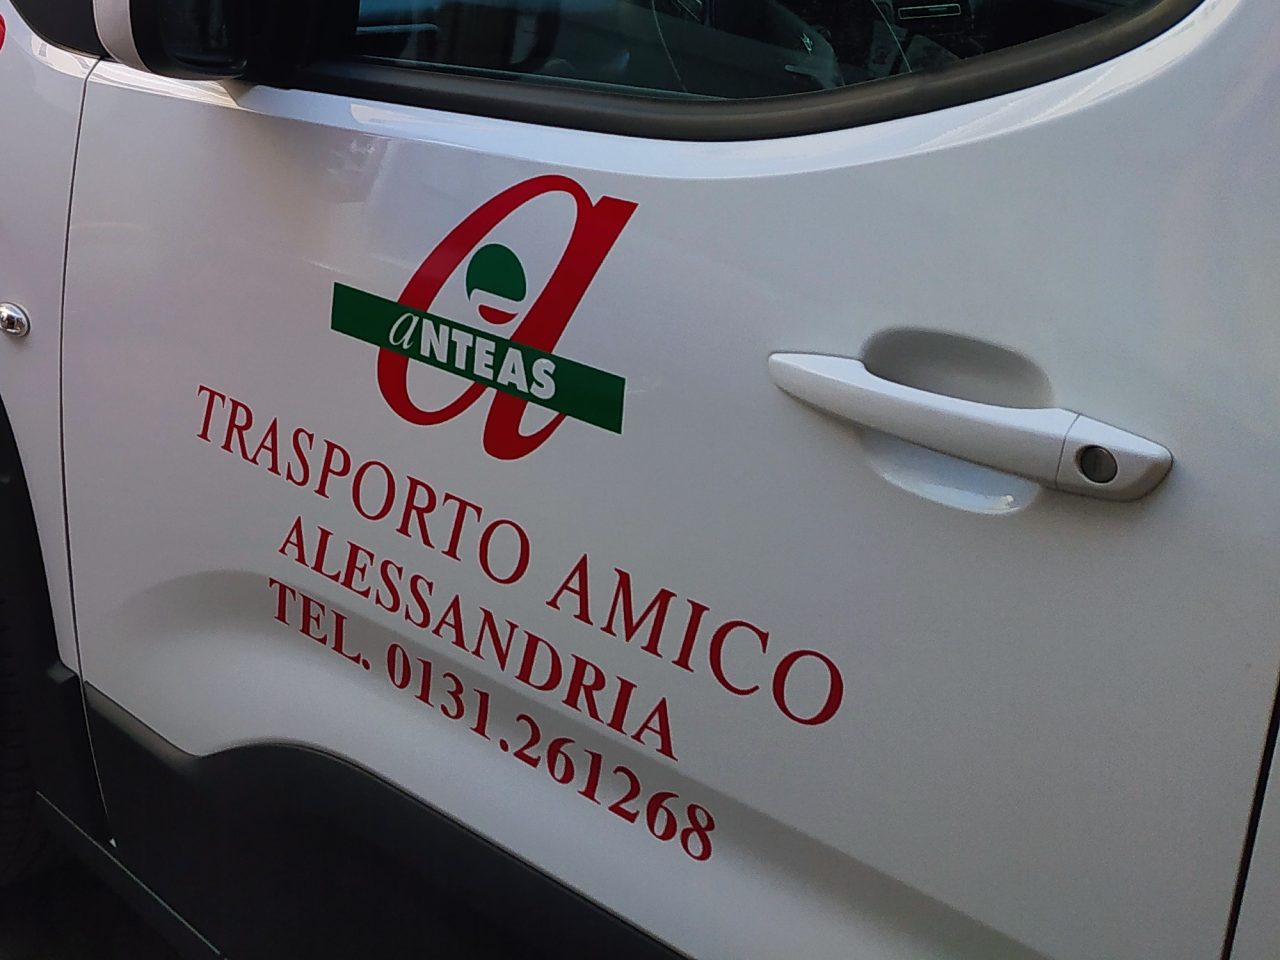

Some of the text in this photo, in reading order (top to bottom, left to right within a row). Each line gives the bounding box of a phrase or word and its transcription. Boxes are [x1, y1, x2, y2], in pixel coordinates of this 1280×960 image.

[195, 385, 845, 728] TRASPORTO AMICO
[278, 515, 679, 762] ALESSANDRIA
[267, 577, 717, 863] TEL. 0131.261268
